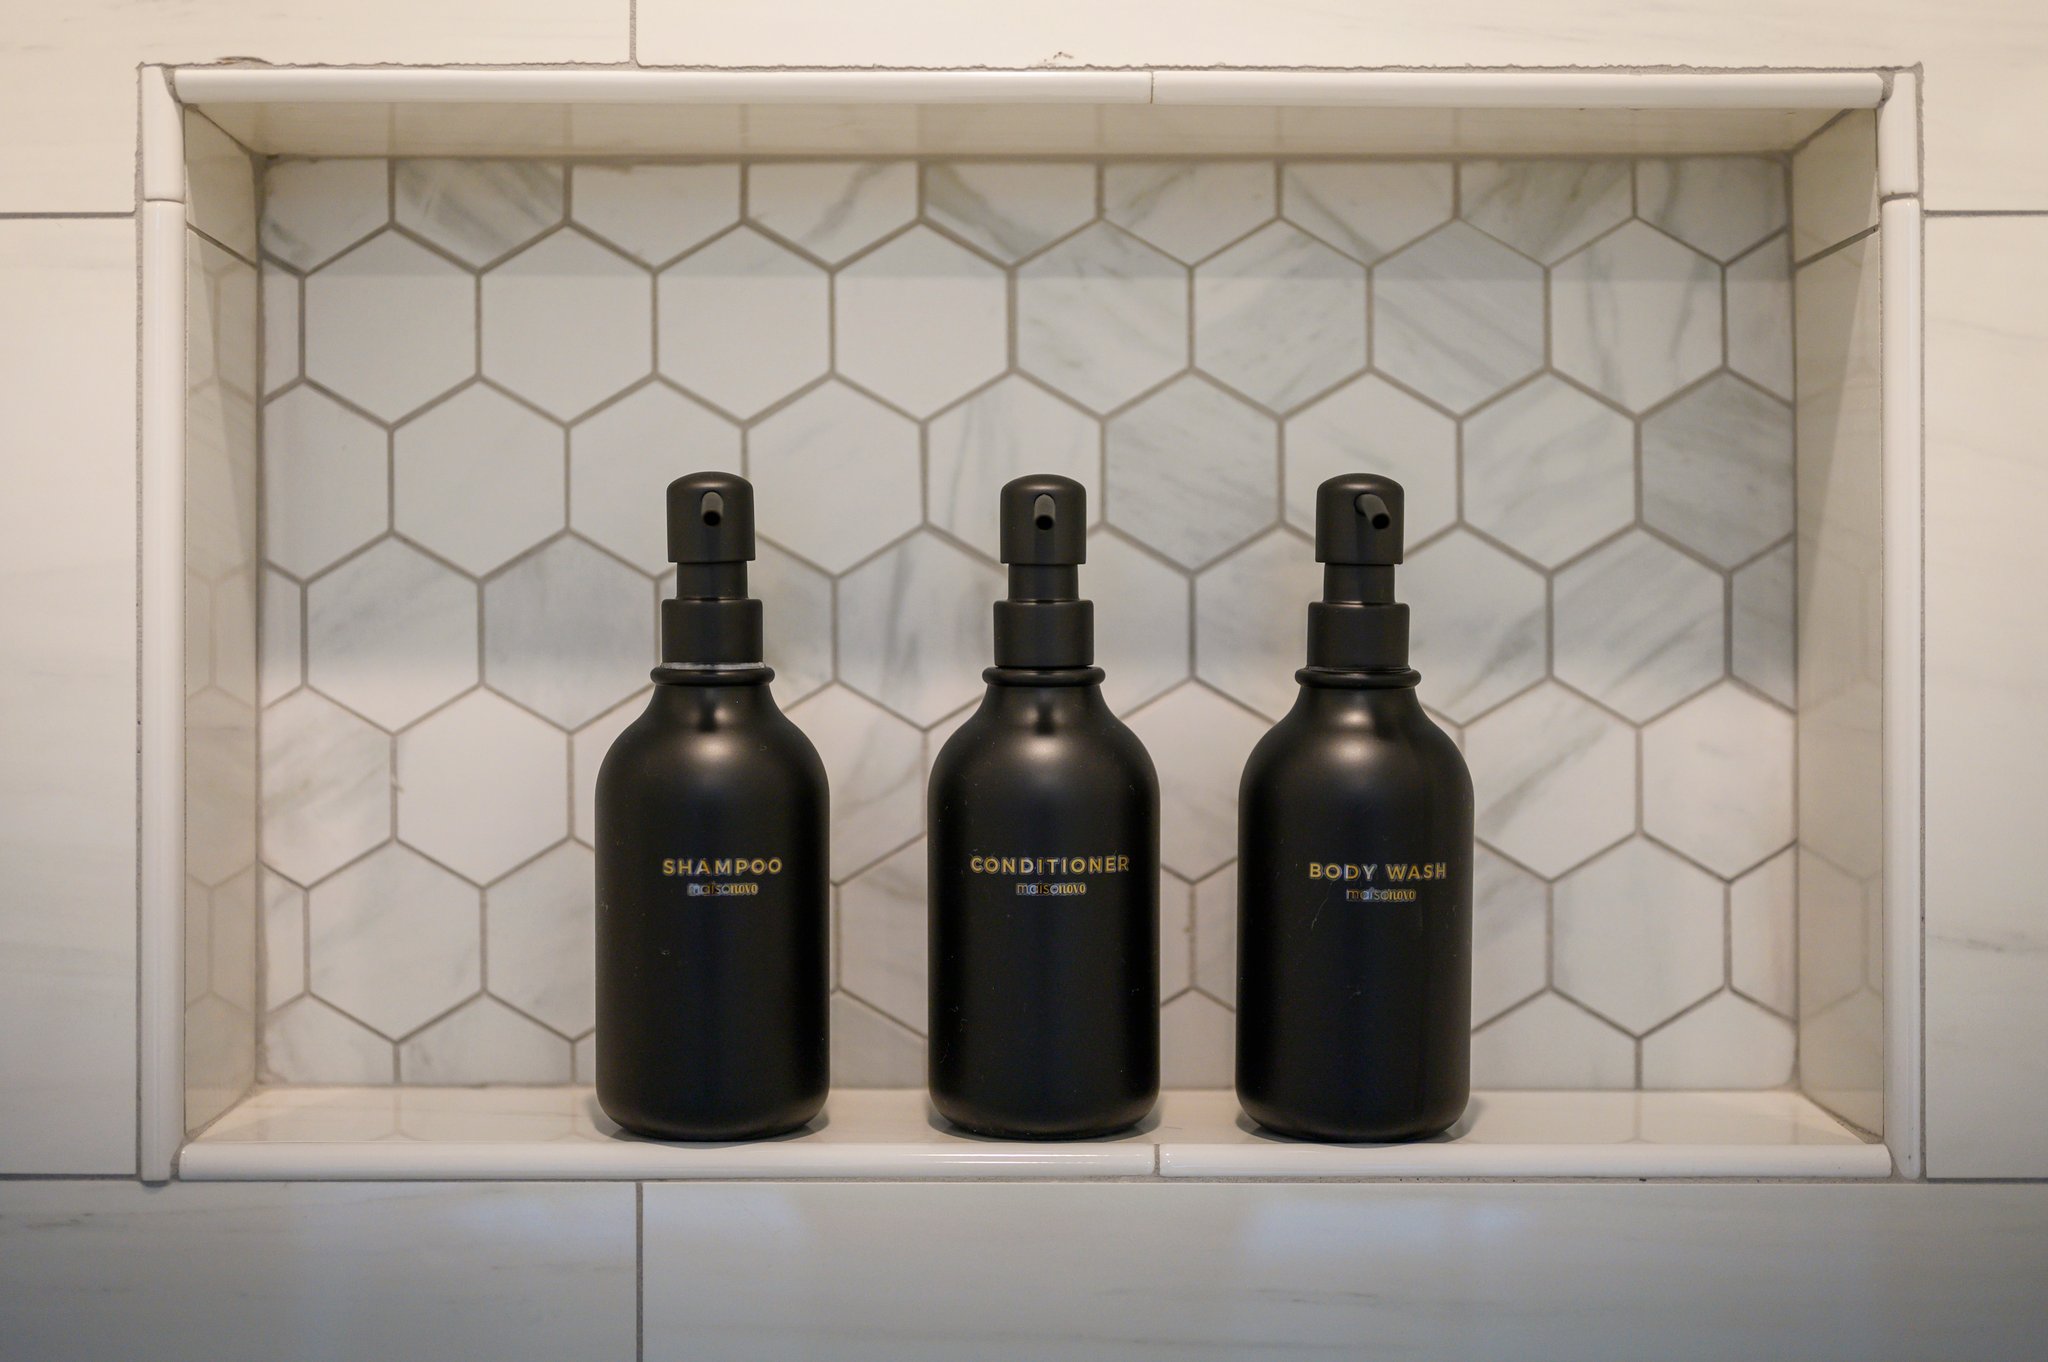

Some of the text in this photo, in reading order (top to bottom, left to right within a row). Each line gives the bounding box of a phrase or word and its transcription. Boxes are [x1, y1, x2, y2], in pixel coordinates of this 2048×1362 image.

[662, 857, 783, 876] SHAMPOO
[969, 855, 1129, 875] CONDITIONER
[1309, 862, 1447, 881] BODY WASH
